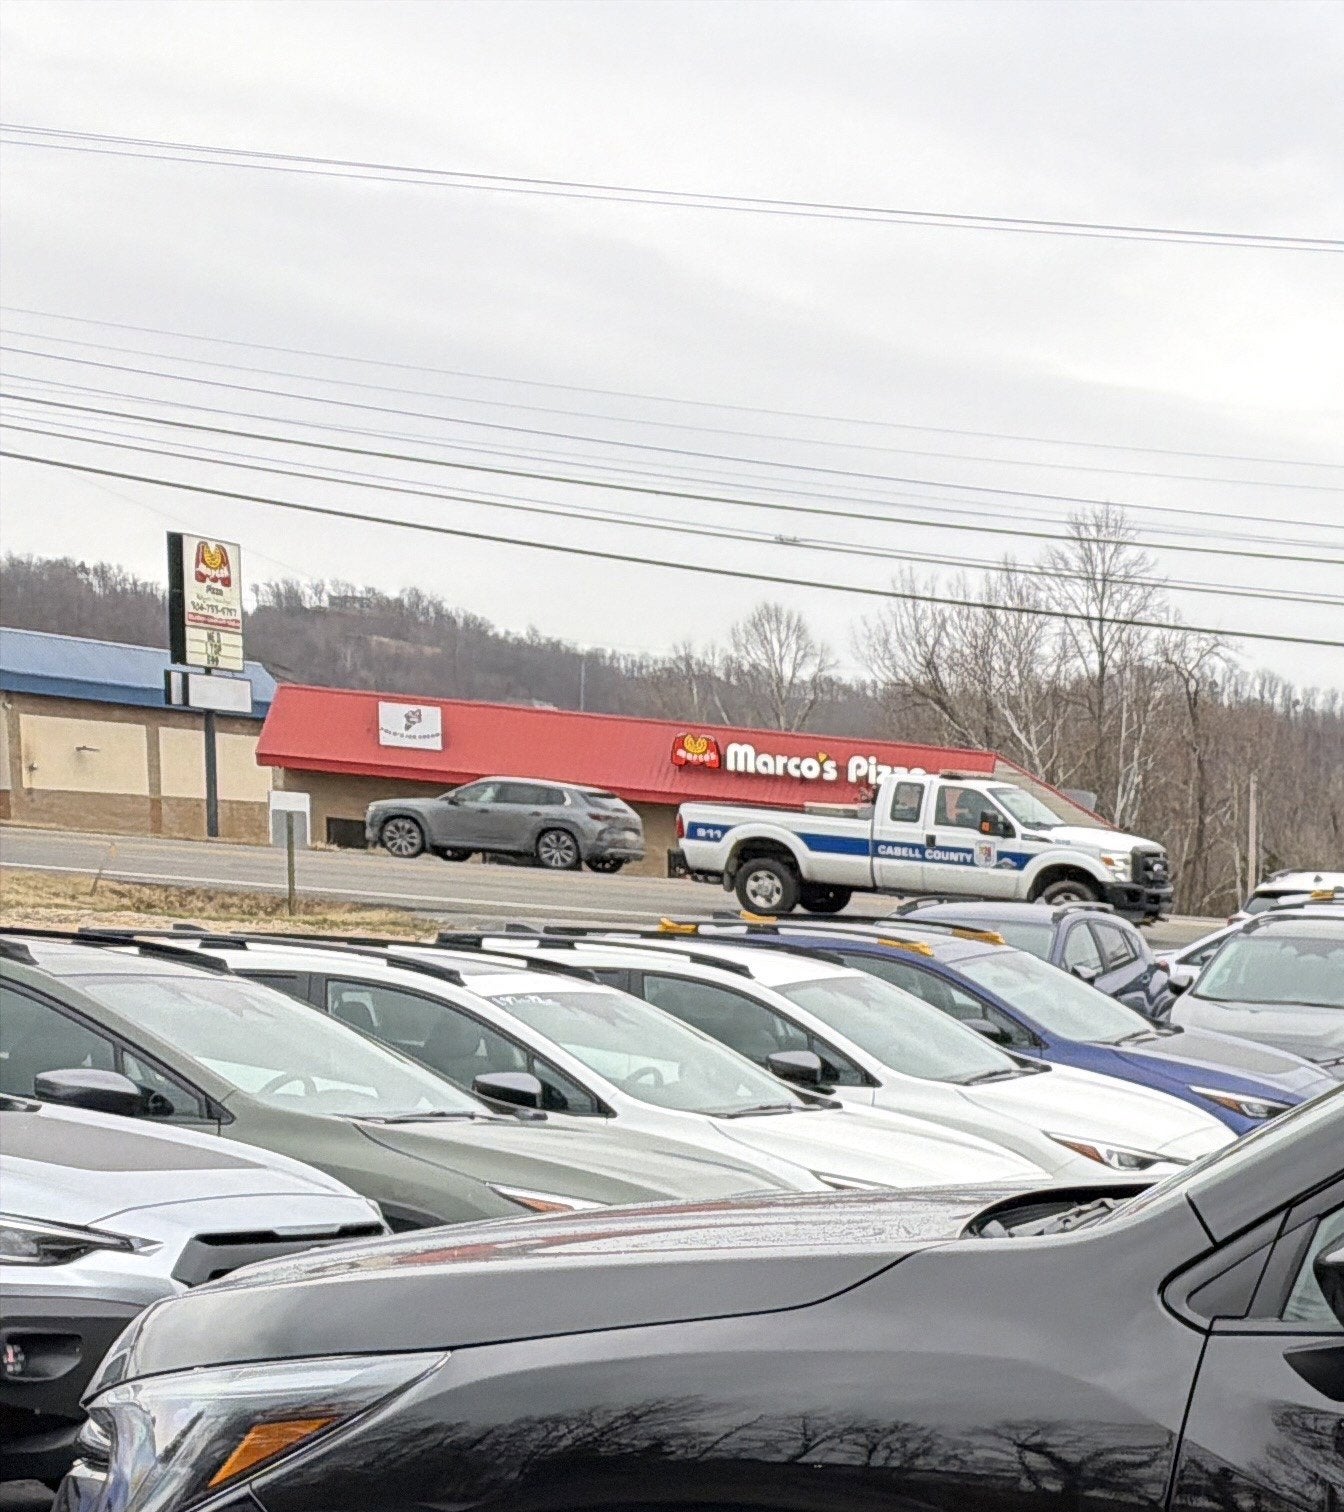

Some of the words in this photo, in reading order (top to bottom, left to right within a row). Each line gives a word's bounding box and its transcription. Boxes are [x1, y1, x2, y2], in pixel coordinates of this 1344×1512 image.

[726, 742, 837, 781] Marco's
[877, 844, 922, 859] CABELL
[924, 848, 974, 864] COUNTY
